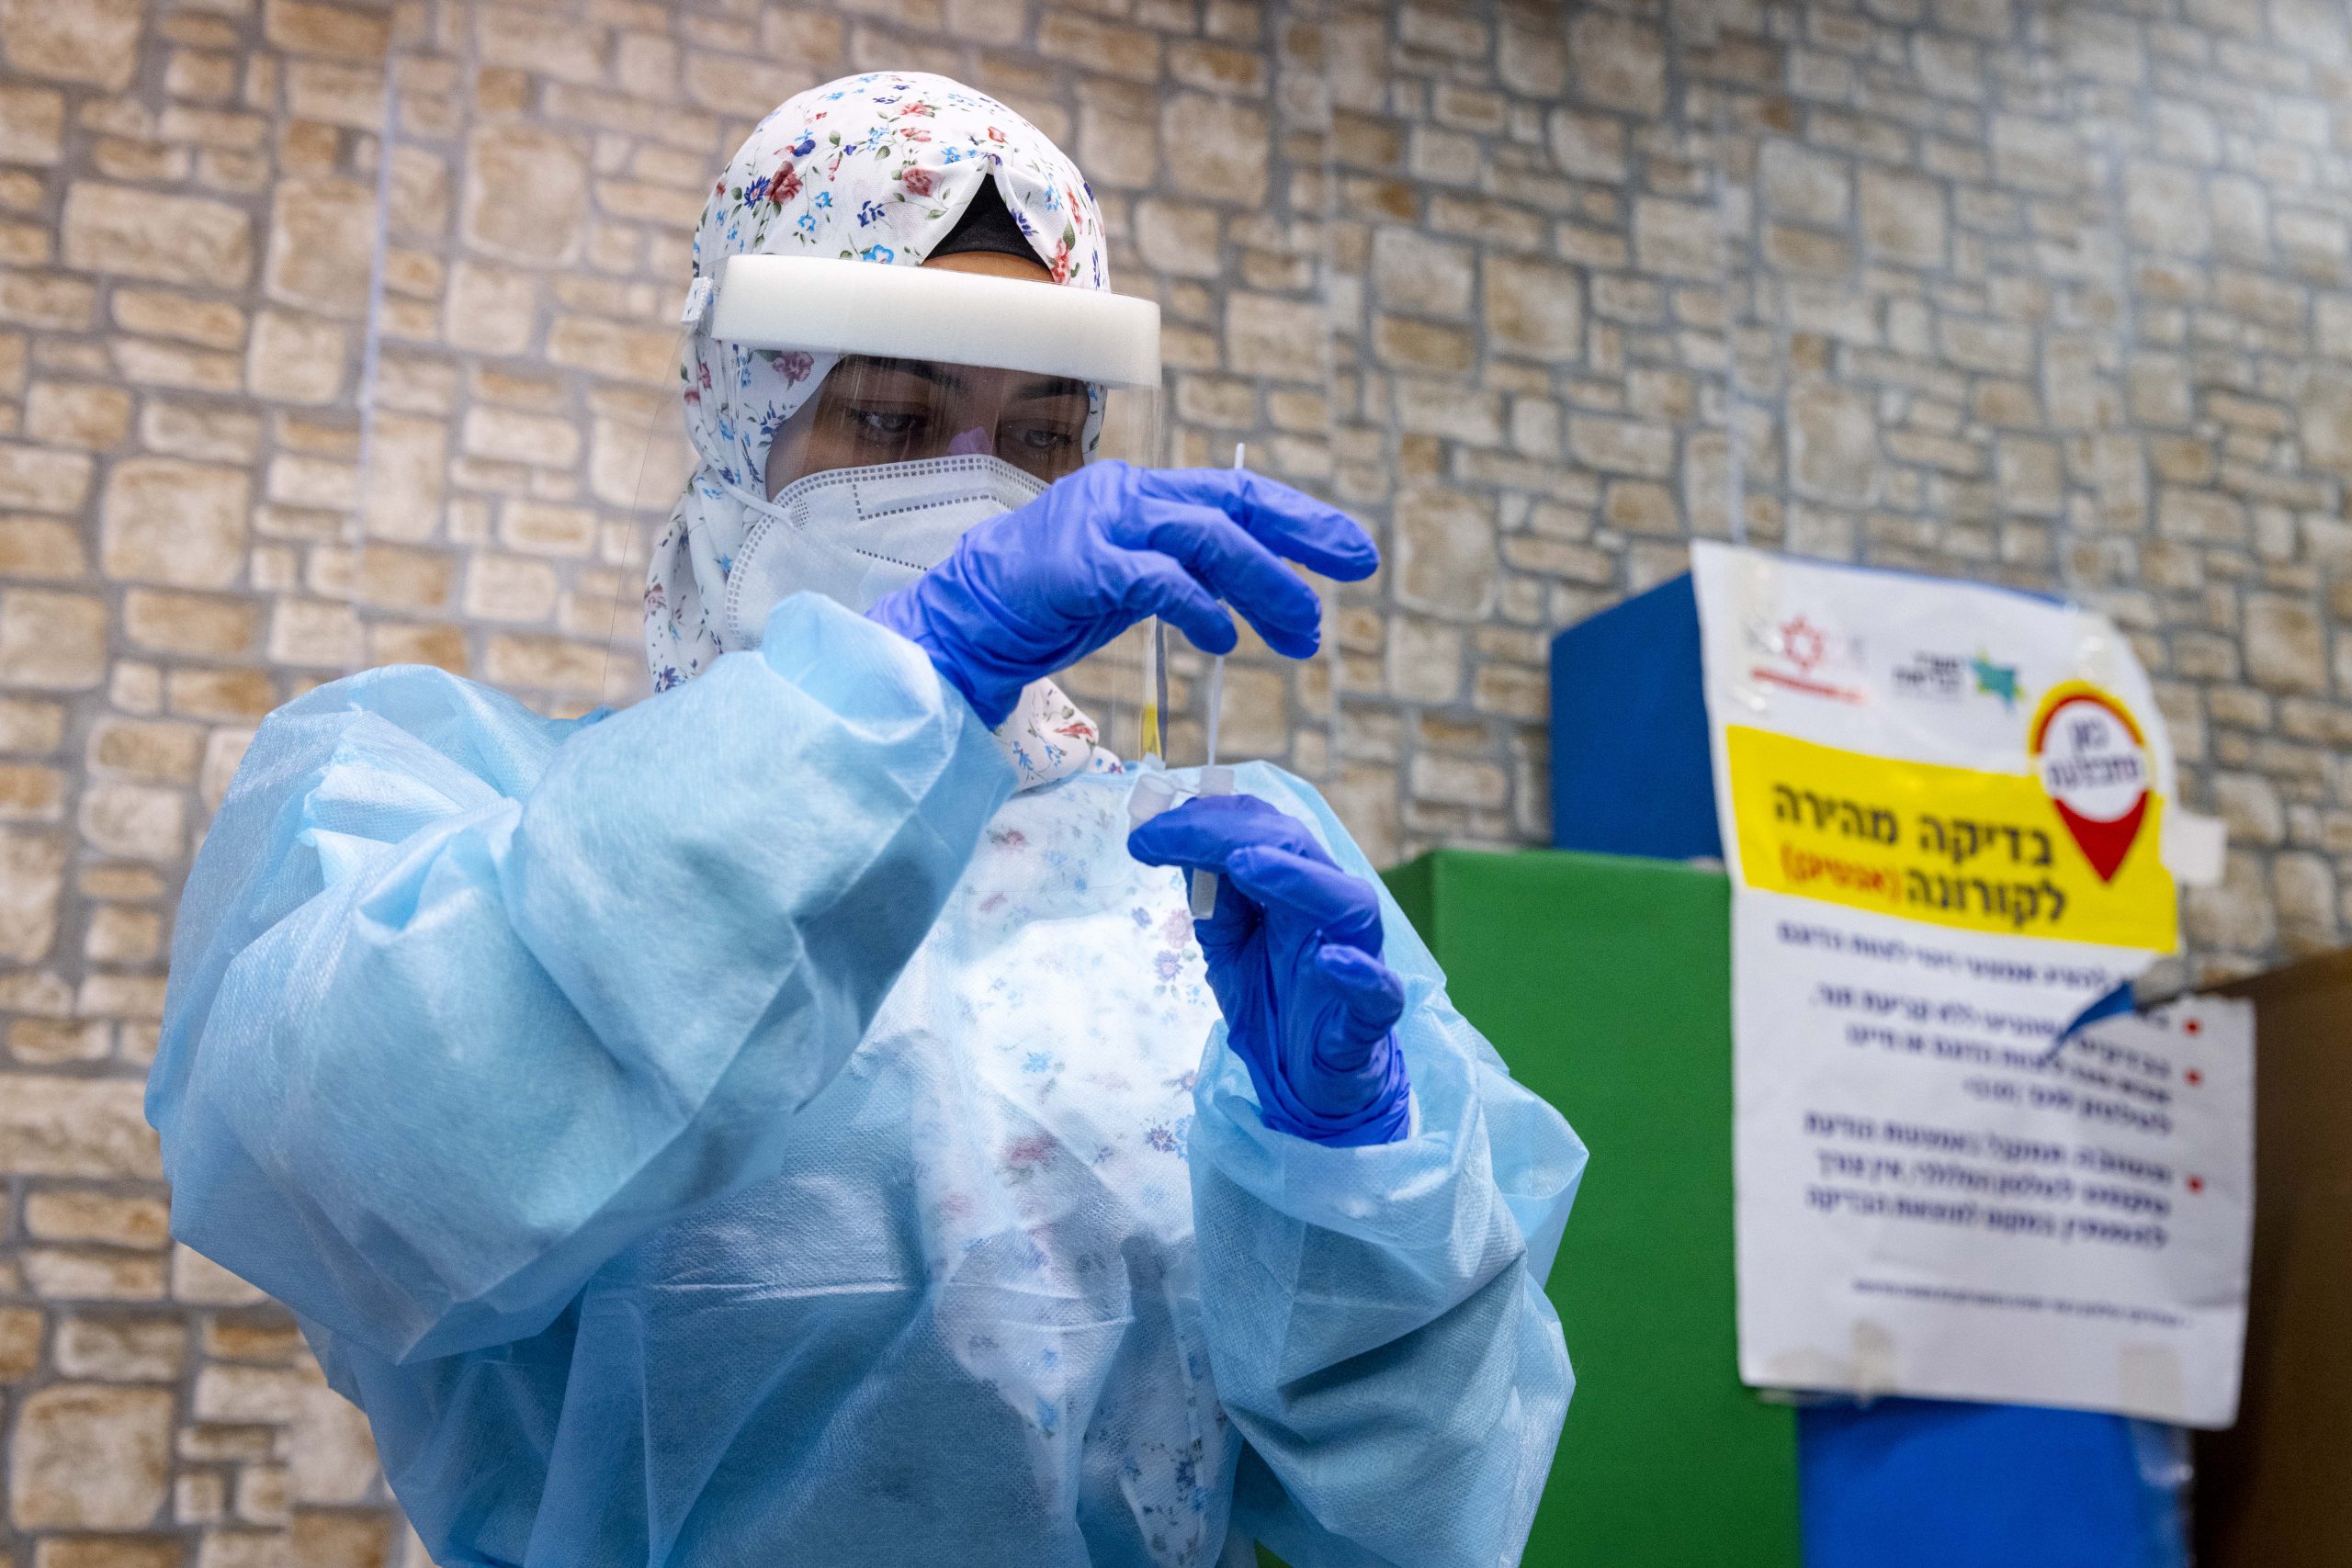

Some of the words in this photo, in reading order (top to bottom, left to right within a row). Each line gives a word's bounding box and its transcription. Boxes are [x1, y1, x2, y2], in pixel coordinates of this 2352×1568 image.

[2069, 719, 2109, 759] כאן
[1774, 784, 1898, 845] מהירה
[1919, 815, 2052, 865] בדיקה
[1906, 868, 2065, 927] לקורונה
